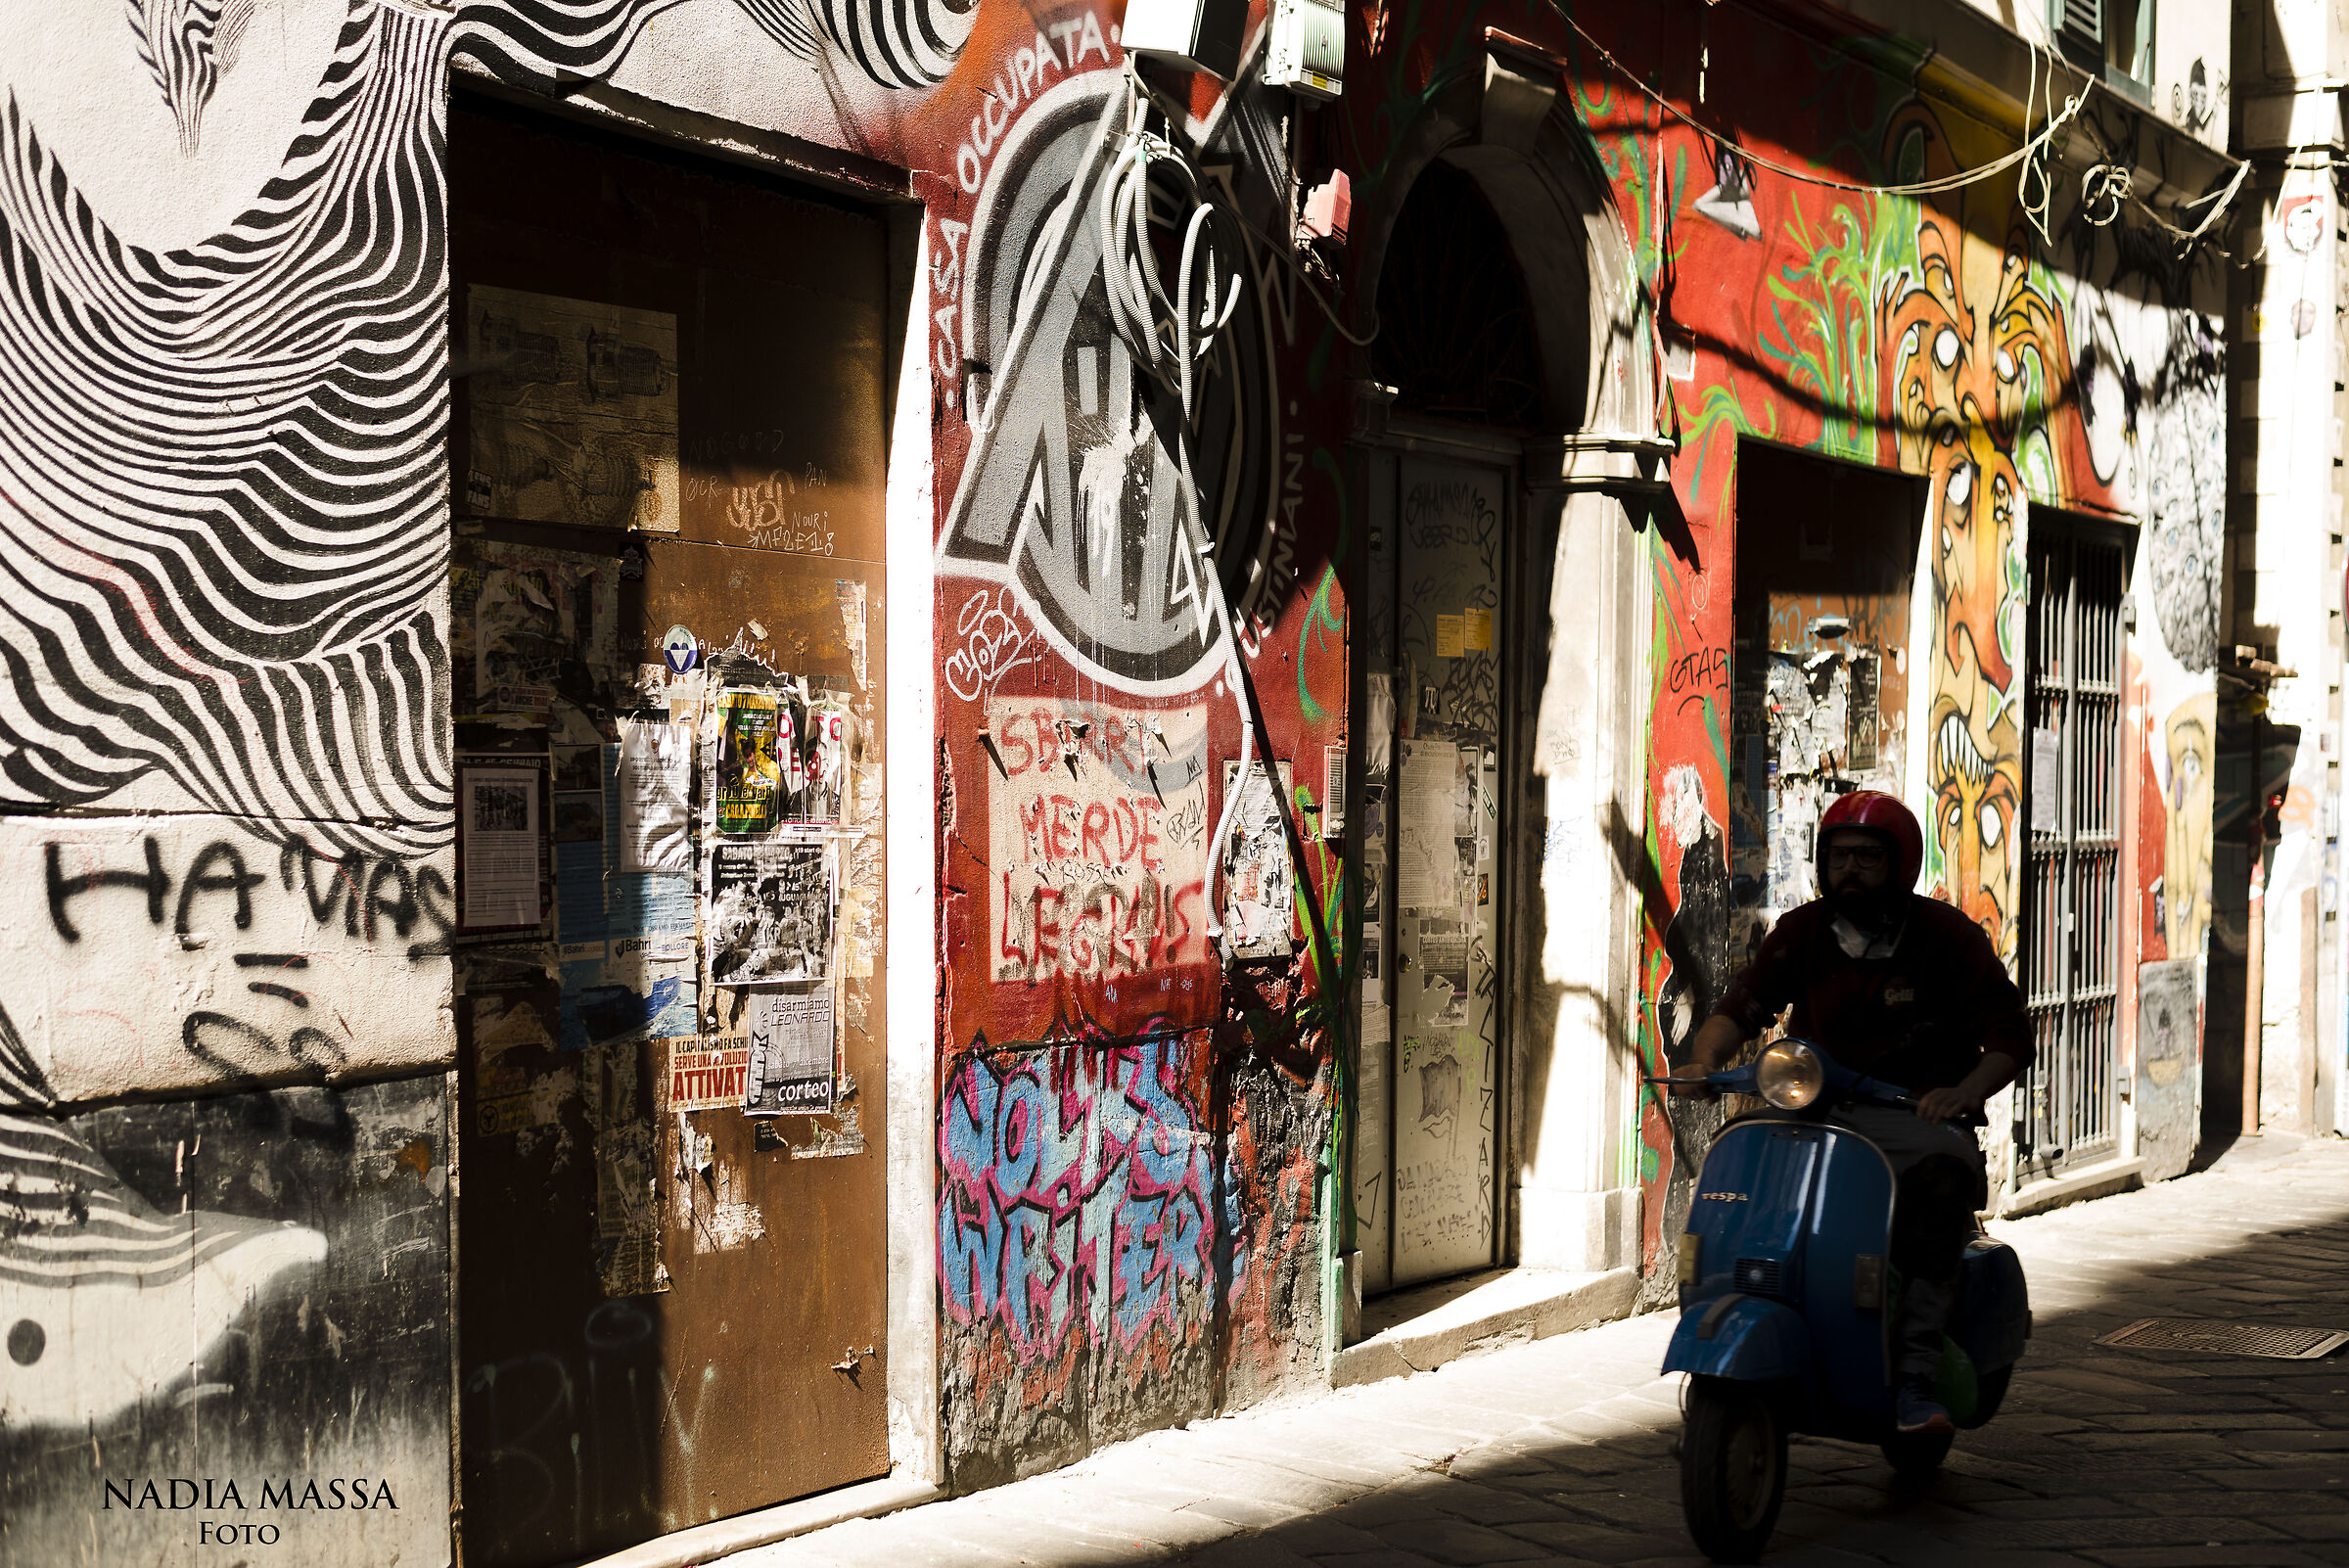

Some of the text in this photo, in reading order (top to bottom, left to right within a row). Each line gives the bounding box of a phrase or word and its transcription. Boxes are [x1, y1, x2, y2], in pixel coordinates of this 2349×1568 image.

[934, 17, 1110, 384] CASA OCCUPATA
[1019, 794, 1164, 871] MERDE
[625, 937, 652, 952] Bahri
[771, 996, 830, 1013] disarmiamo
[770, 1010, 831, 1027] LEONARDO
[674, 1054, 697, 1071] SERVE
[697, 1053, 712, 1068] UNA
[778, 1080, 829, 1103] corteo
